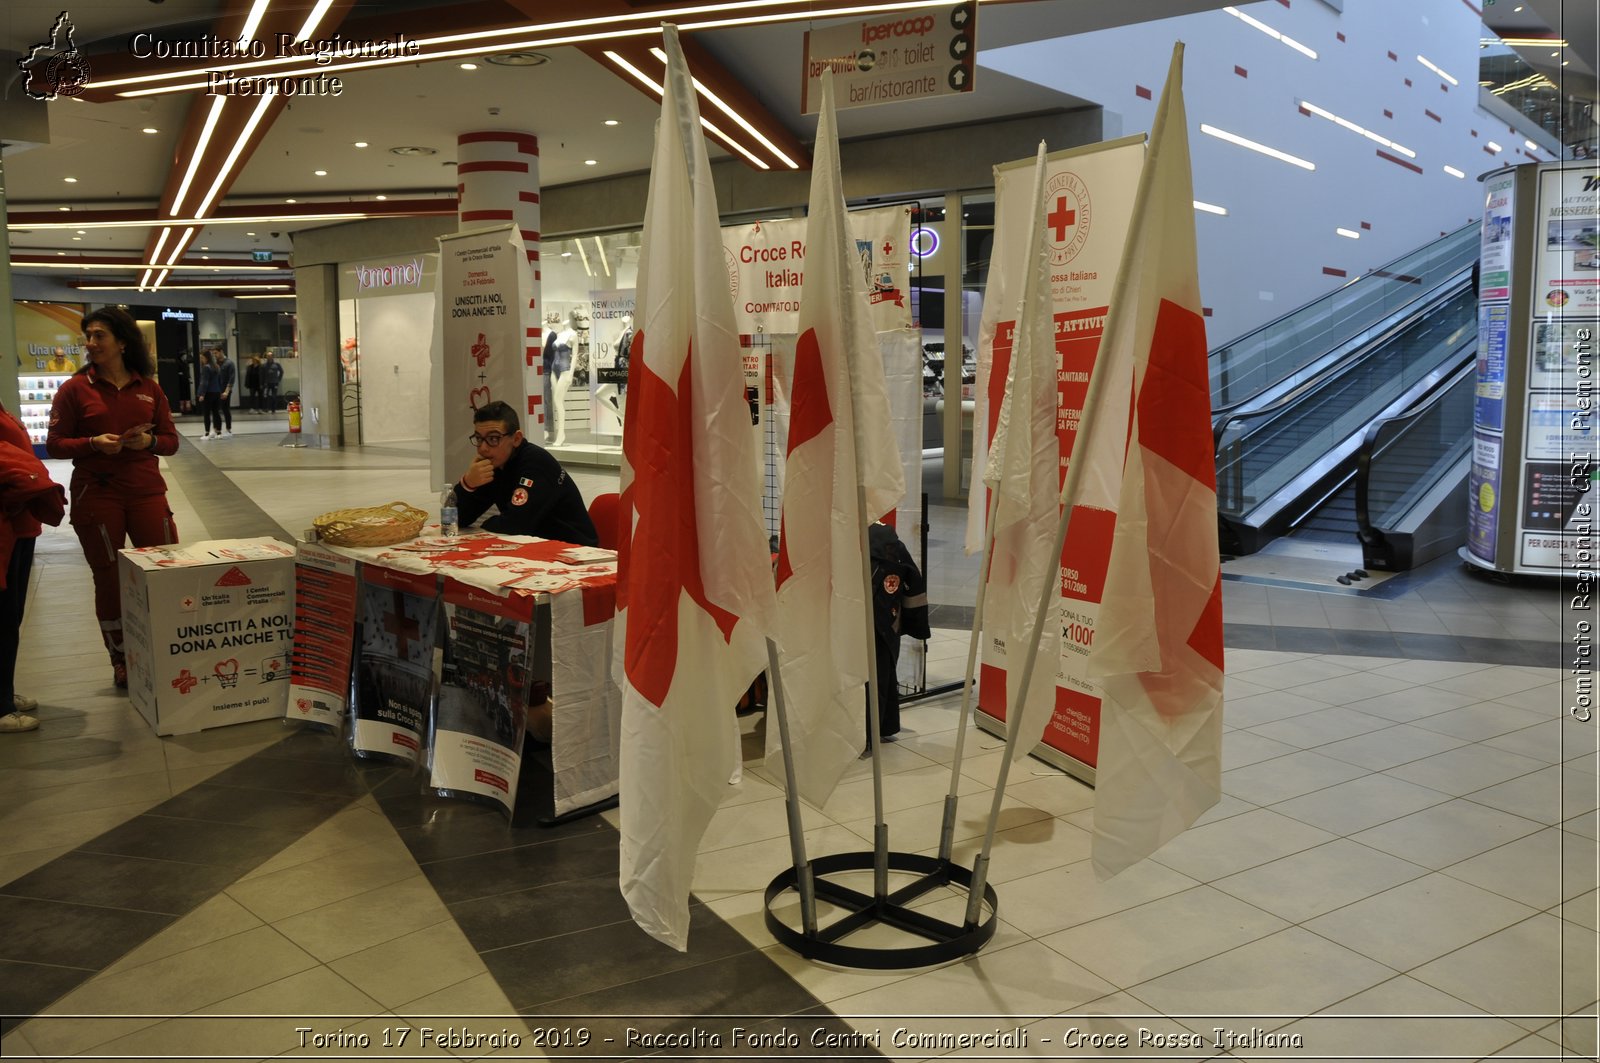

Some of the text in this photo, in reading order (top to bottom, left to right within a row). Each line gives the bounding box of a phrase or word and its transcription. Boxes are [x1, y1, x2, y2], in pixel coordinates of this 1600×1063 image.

[862, 14, 935, 45] ipercoop
[904, 42, 936, 65] toilet
[850, 76, 936, 103] bar/ristorante
[740, 244, 786, 264] Croce
[355, 258, 424, 293] yamamay
[477, 277, 496, 285] Febbraio
[1050, 271, 1097, 282] ossa Italiana
[455, 295, 482, 306] UNISCITI
[489, 293, 503, 304] NOI,
[592, 301, 607, 309] NEW
[870, 294, 883, 303] ERI
[452, 304, 507, 318] DONA ANCHE TU!
[745, 301, 791, 314] COMITATO
[1063, 315, 1105, 331] ATTIVIT
[29, 344, 81, 356] Una nvità
[37, 358, 46, 369] in
[1057, 372, 1088, 383] SANITARIA
[1528, 538, 1541, 548] PER
[1064, 579, 1087, 595] 81/2008
[247, 590, 287, 600] Commerciali
[176, 614, 292, 639] UNISCITI A NOI,
[1082, 614, 1094, 626] TUO
[170, 639, 216, 656] DONA
[221, 632, 273, 649] ANCHE
[213, 702, 244, 711] Insieme
[253, 696, 270, 708] può!
[388, 698, 402, 711] Non
[377, 709, 396, 720] sulla
[397, 712, 415, 726] Croce
